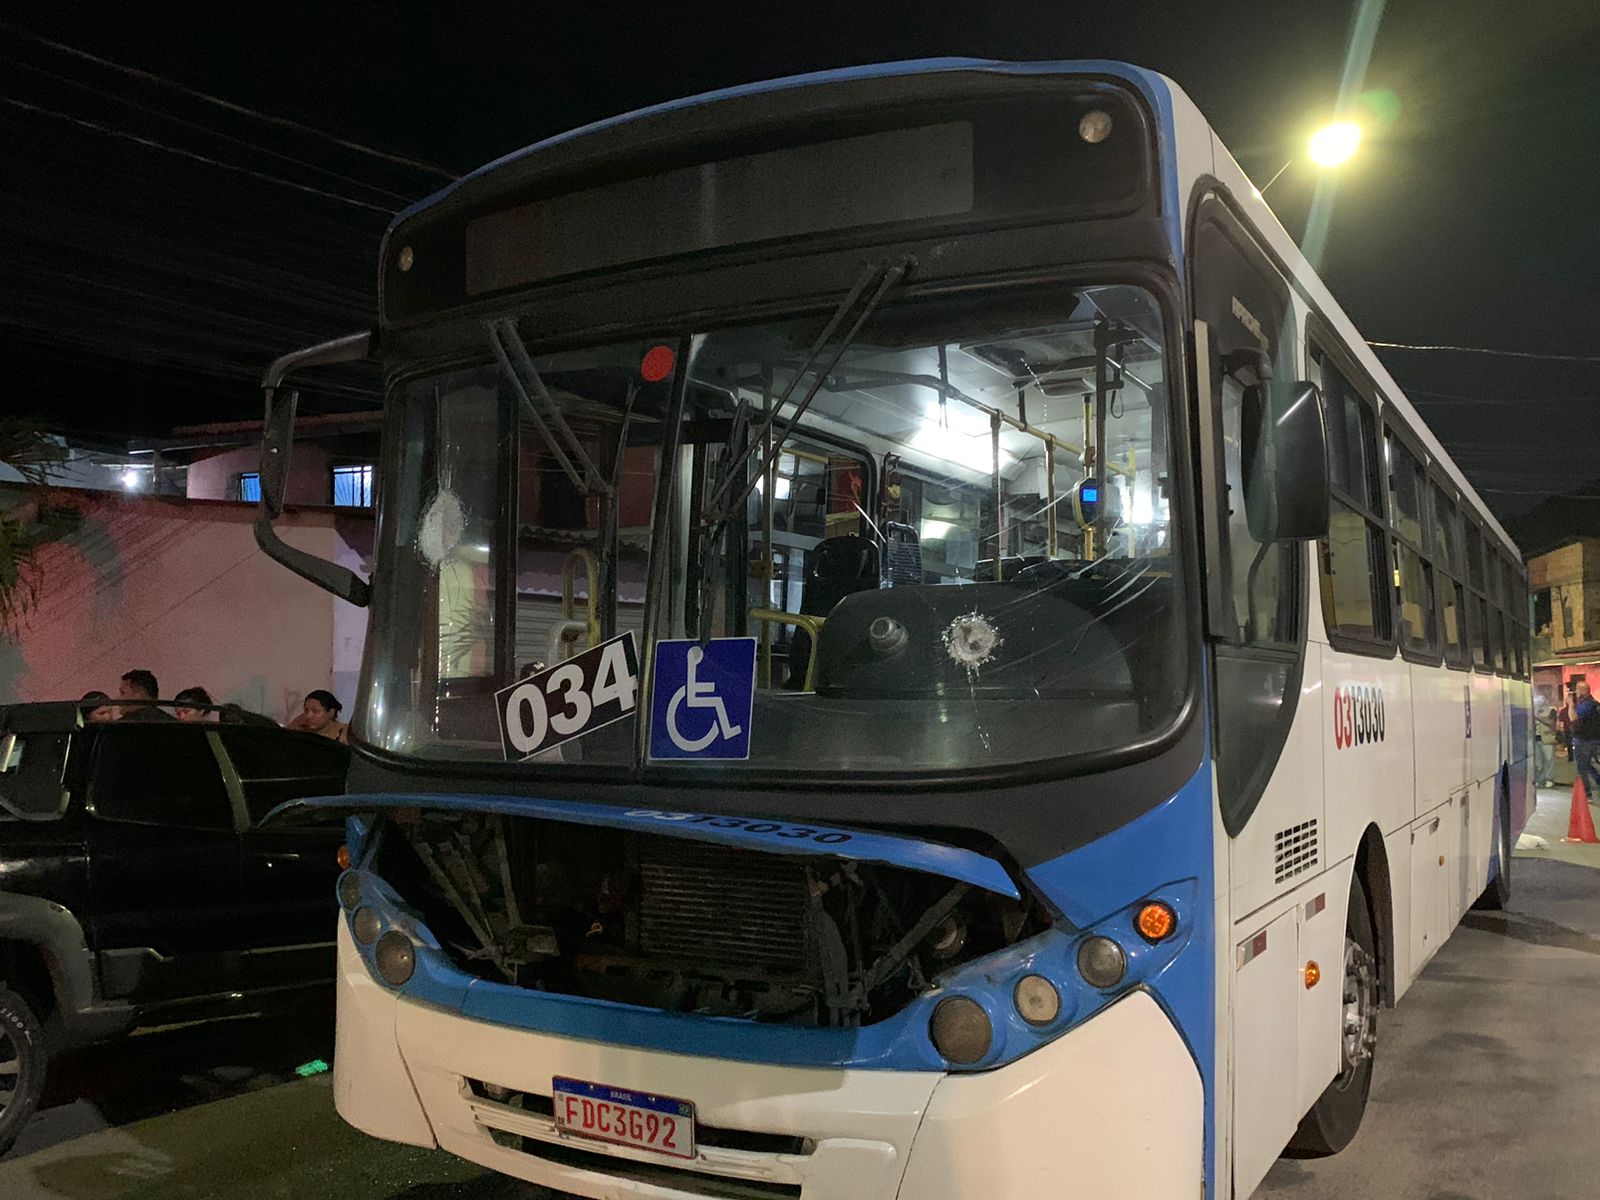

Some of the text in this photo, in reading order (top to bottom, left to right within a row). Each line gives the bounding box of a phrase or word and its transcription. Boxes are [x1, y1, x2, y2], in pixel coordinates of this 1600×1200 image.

[505, 640, 638, 753] 034
[1334, 686, 1385, 750] 0313030
[565, 1096, 676, 1149] FDC3G92
